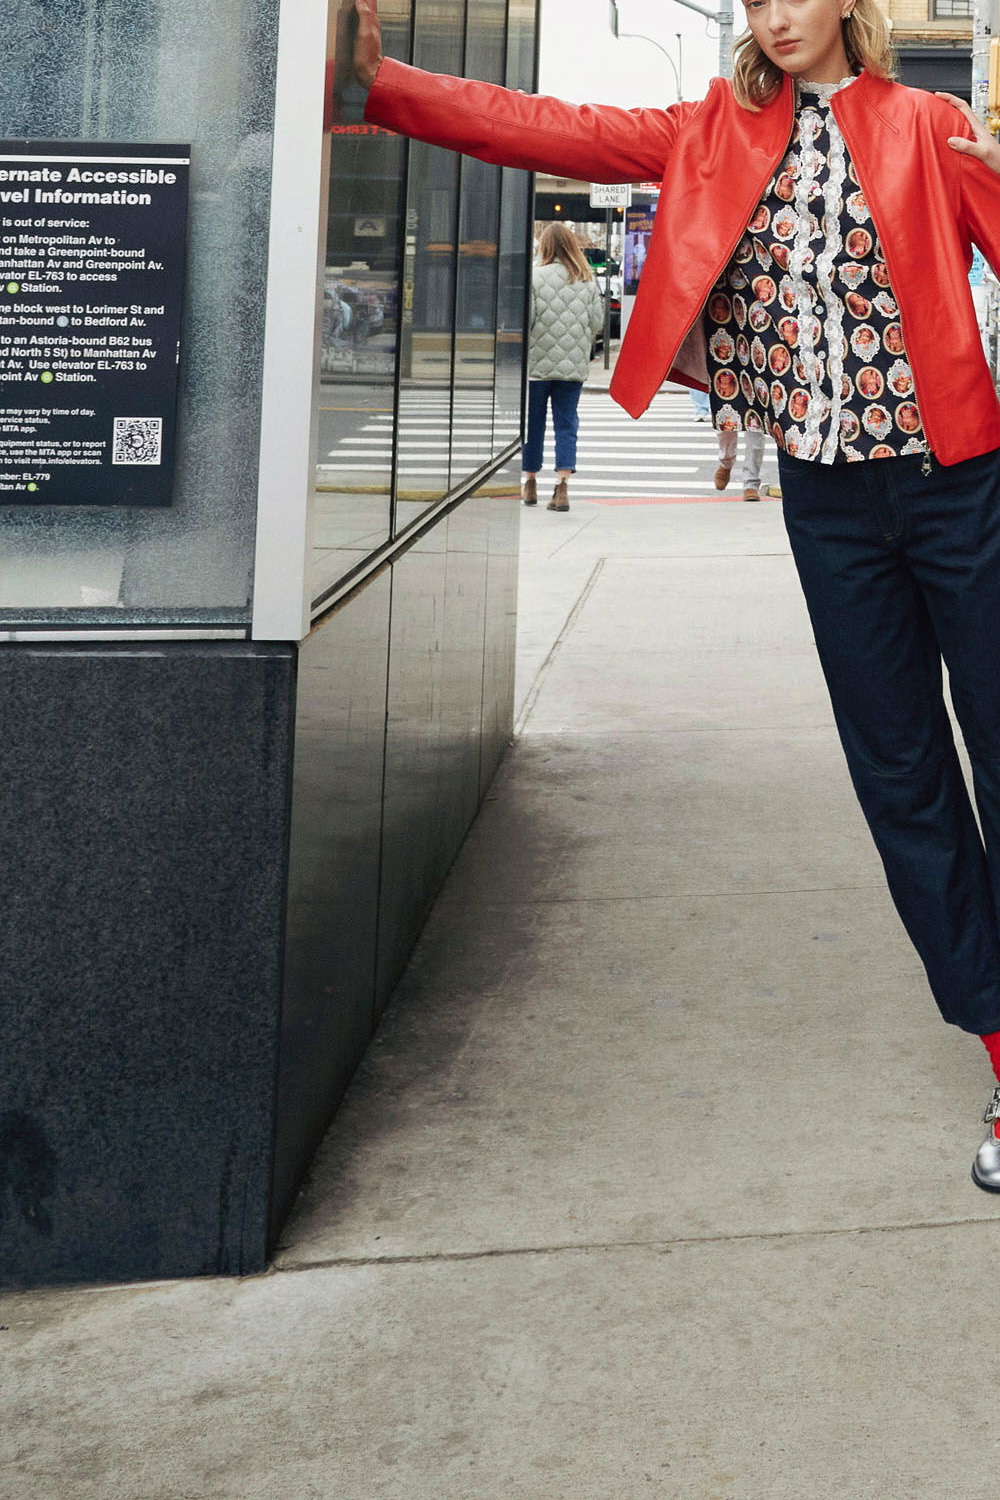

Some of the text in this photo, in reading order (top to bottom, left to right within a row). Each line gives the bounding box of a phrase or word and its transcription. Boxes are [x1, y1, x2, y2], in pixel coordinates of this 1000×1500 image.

[66, 168, 176, 184] Accessible
[35, 189, 151, 205] Information
[2, 217, 89, 227] is out of service:
[19, 235, 86, 246] Metropolitan
[88, 236, 103, 244] Av
[104, 236, 115, 245] to
[14, 247, 37, 256] take
[47, 246, 145, 258] Greenpoint-bound
[47, 259, 61, 268] Av
[63, 259, 83, 268] and
[85, 260, 145, 271] Greenpoint
[147, 261, 164, 270] Av.
[28, 271, 64, 280] EL-763
[66, 272, 77, 281] to
[21, 283, 62, 292] Station.
[13, 304, 43, 313] block
[45, 305, 71, 313] west
[73, 305, 84, 313] to
[86, 305, 128, 314] Lorimer
[130, 305, 142, 314] St
[144, 306, 164, 314] and
[71, 317, 82, 325] to
[84, 317, 127, 326] Bedford
[130, 317, 146, 326] Av.
[0, 336, 12, 344] to
[29, 335, 107, 345] Astoria-bound
[109, 336, 130, 346] B62
[132, 337, 152, 346] bus
[11, 347, 42, 356] North
[44, 348, 51, 357] 5
[53, 348, 68, 359] St)
[70, 349, 81, 357] to
[84, 348, 140, 358] Manhattan
[142, 349, 156, 358] Av
[7, 359, 24, 368] Av.
[29, 360, 50, 369] Use
[52, 360, 95, 369] elevator
[97, 361, 134, 370] EL-763
[136, 362, 147, 370] to
[0, 372, 22, 381] oint
[24, 372, 38, 381] Av
[55, 372, 96, 381] Station.
[80, 409, 95, 417] day.
